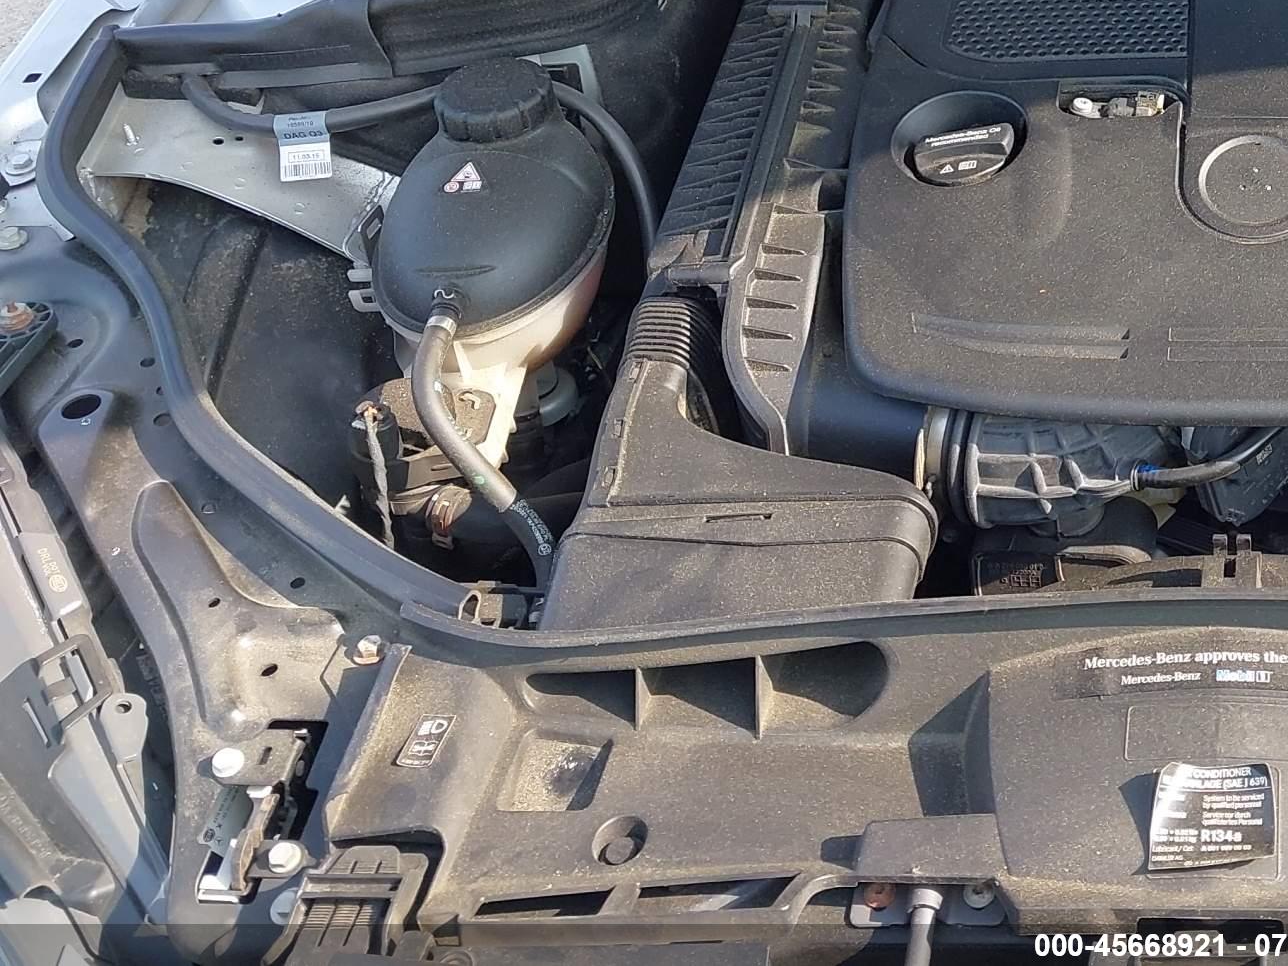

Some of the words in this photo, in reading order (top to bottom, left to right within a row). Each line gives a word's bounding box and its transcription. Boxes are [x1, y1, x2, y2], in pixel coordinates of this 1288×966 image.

[1084, 652, 1192, 670] Mercedes-Benz
[1195, 651, 1260, 665] approves
[1121, 672, 1202, 686] Mercedes-Benz
[1193, 767, 1252, 779] CONDITIONER
[1201, 829, 1243, 842] R134a
